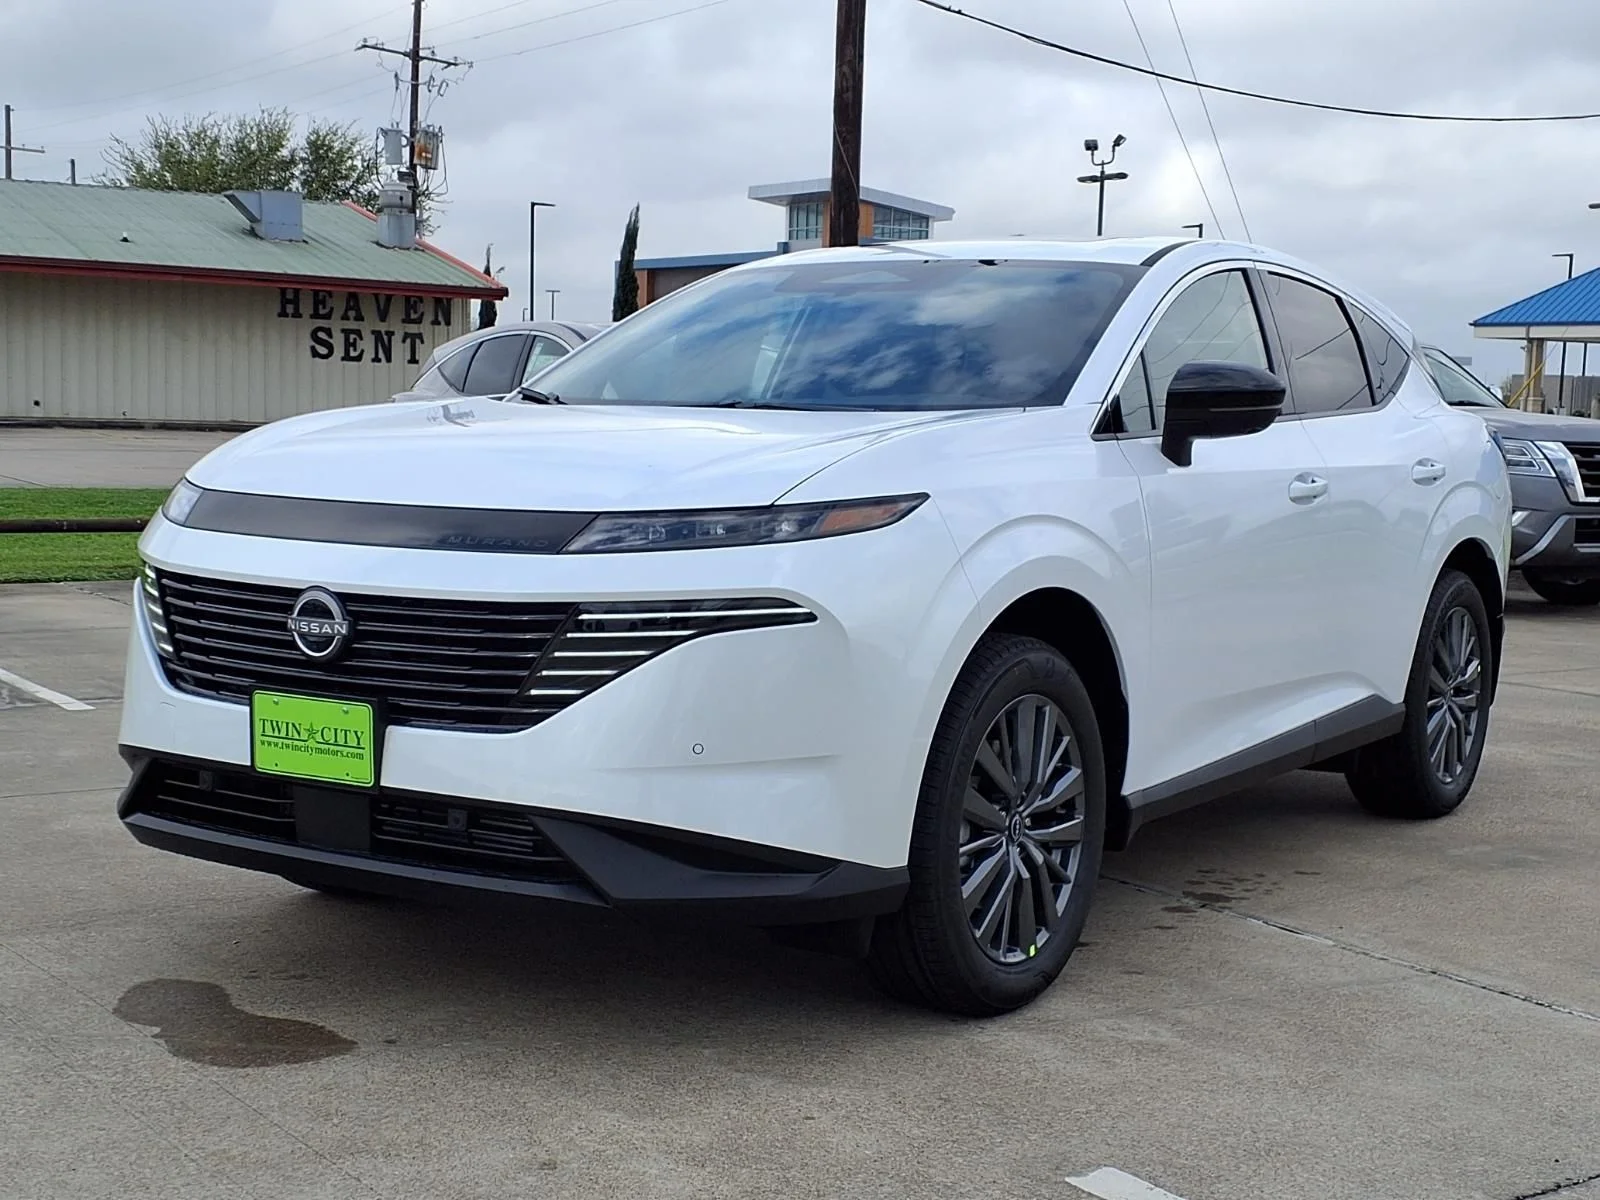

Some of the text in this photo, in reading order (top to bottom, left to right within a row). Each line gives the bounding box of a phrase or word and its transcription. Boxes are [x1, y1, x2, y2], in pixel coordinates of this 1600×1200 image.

[277, 288, 452, 326] HEAVEN
[310, 325, 425, 364] SENT
[447, 535, 550, 548] MURANO
[287, 618, 347, 635] NISSAN
[259, 718, 365, 746] TWIN CITY
[260, 738, 365, 761] www.twincitymotors.com
